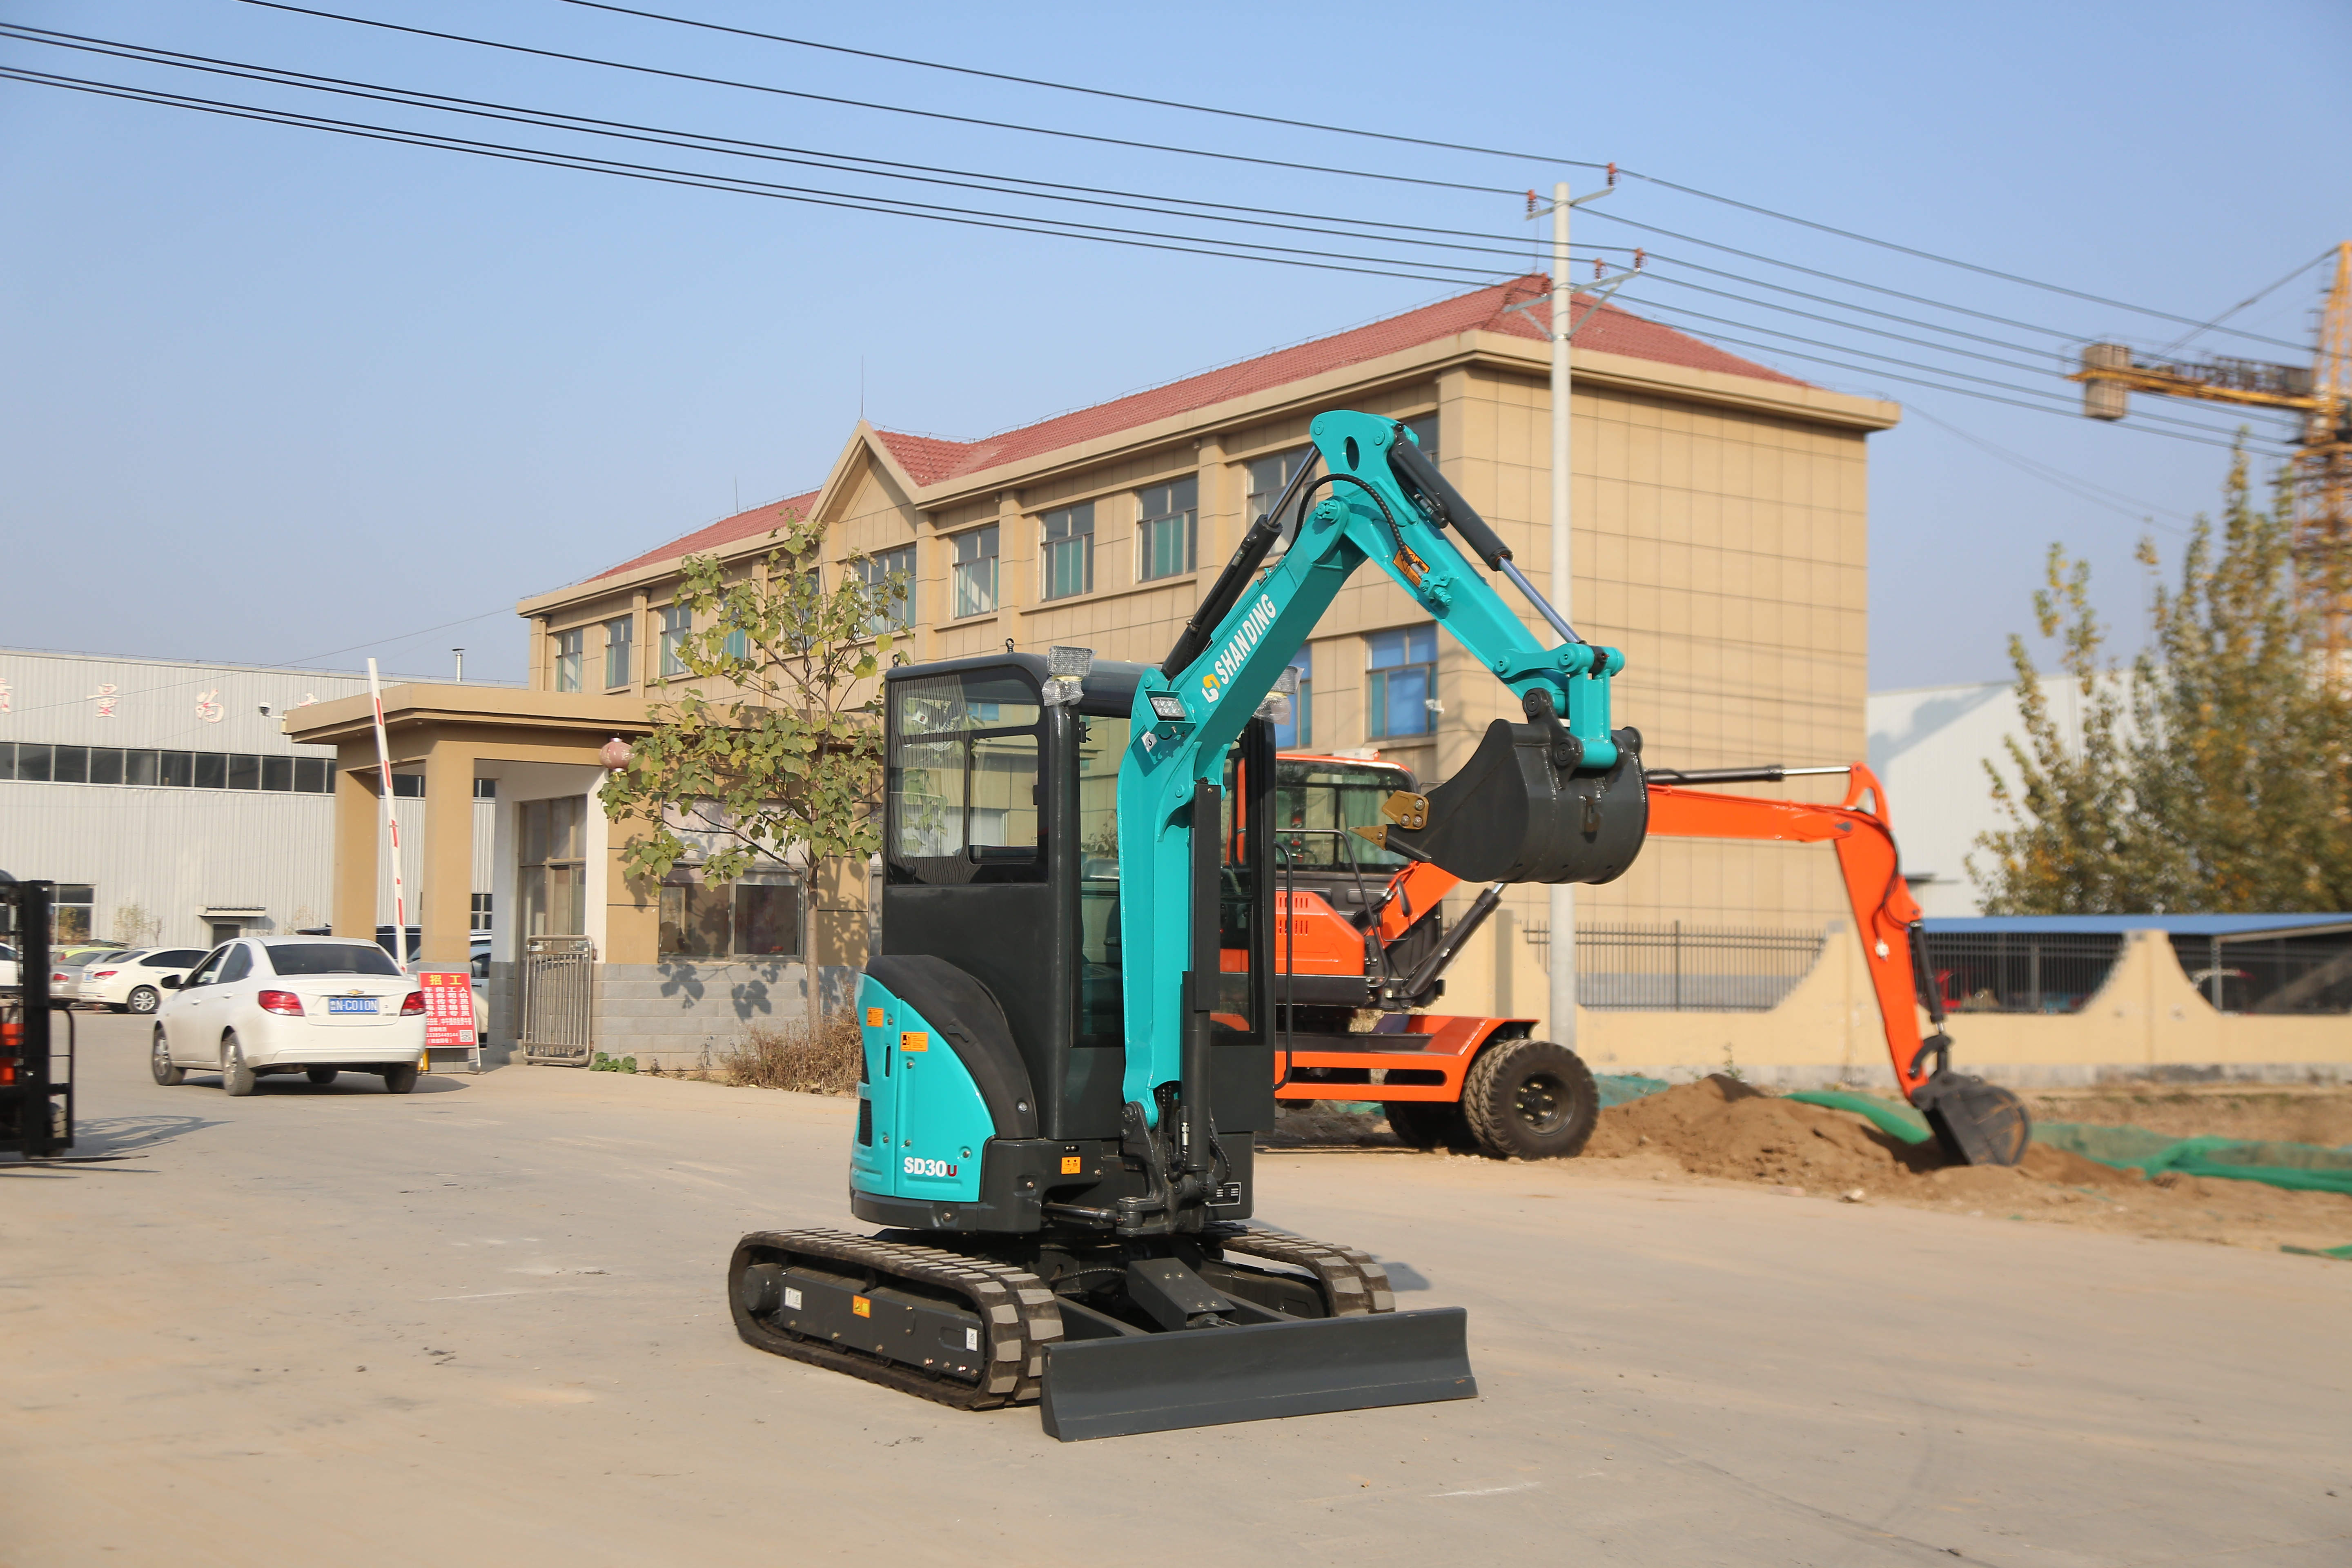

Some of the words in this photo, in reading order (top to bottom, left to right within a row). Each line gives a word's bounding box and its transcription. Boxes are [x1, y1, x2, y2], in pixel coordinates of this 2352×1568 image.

[1215, 594, 1276, 685] SHANDING
[430, 974, 462, 985] 招工
[904, 1156, 958, 1177] SD30U
